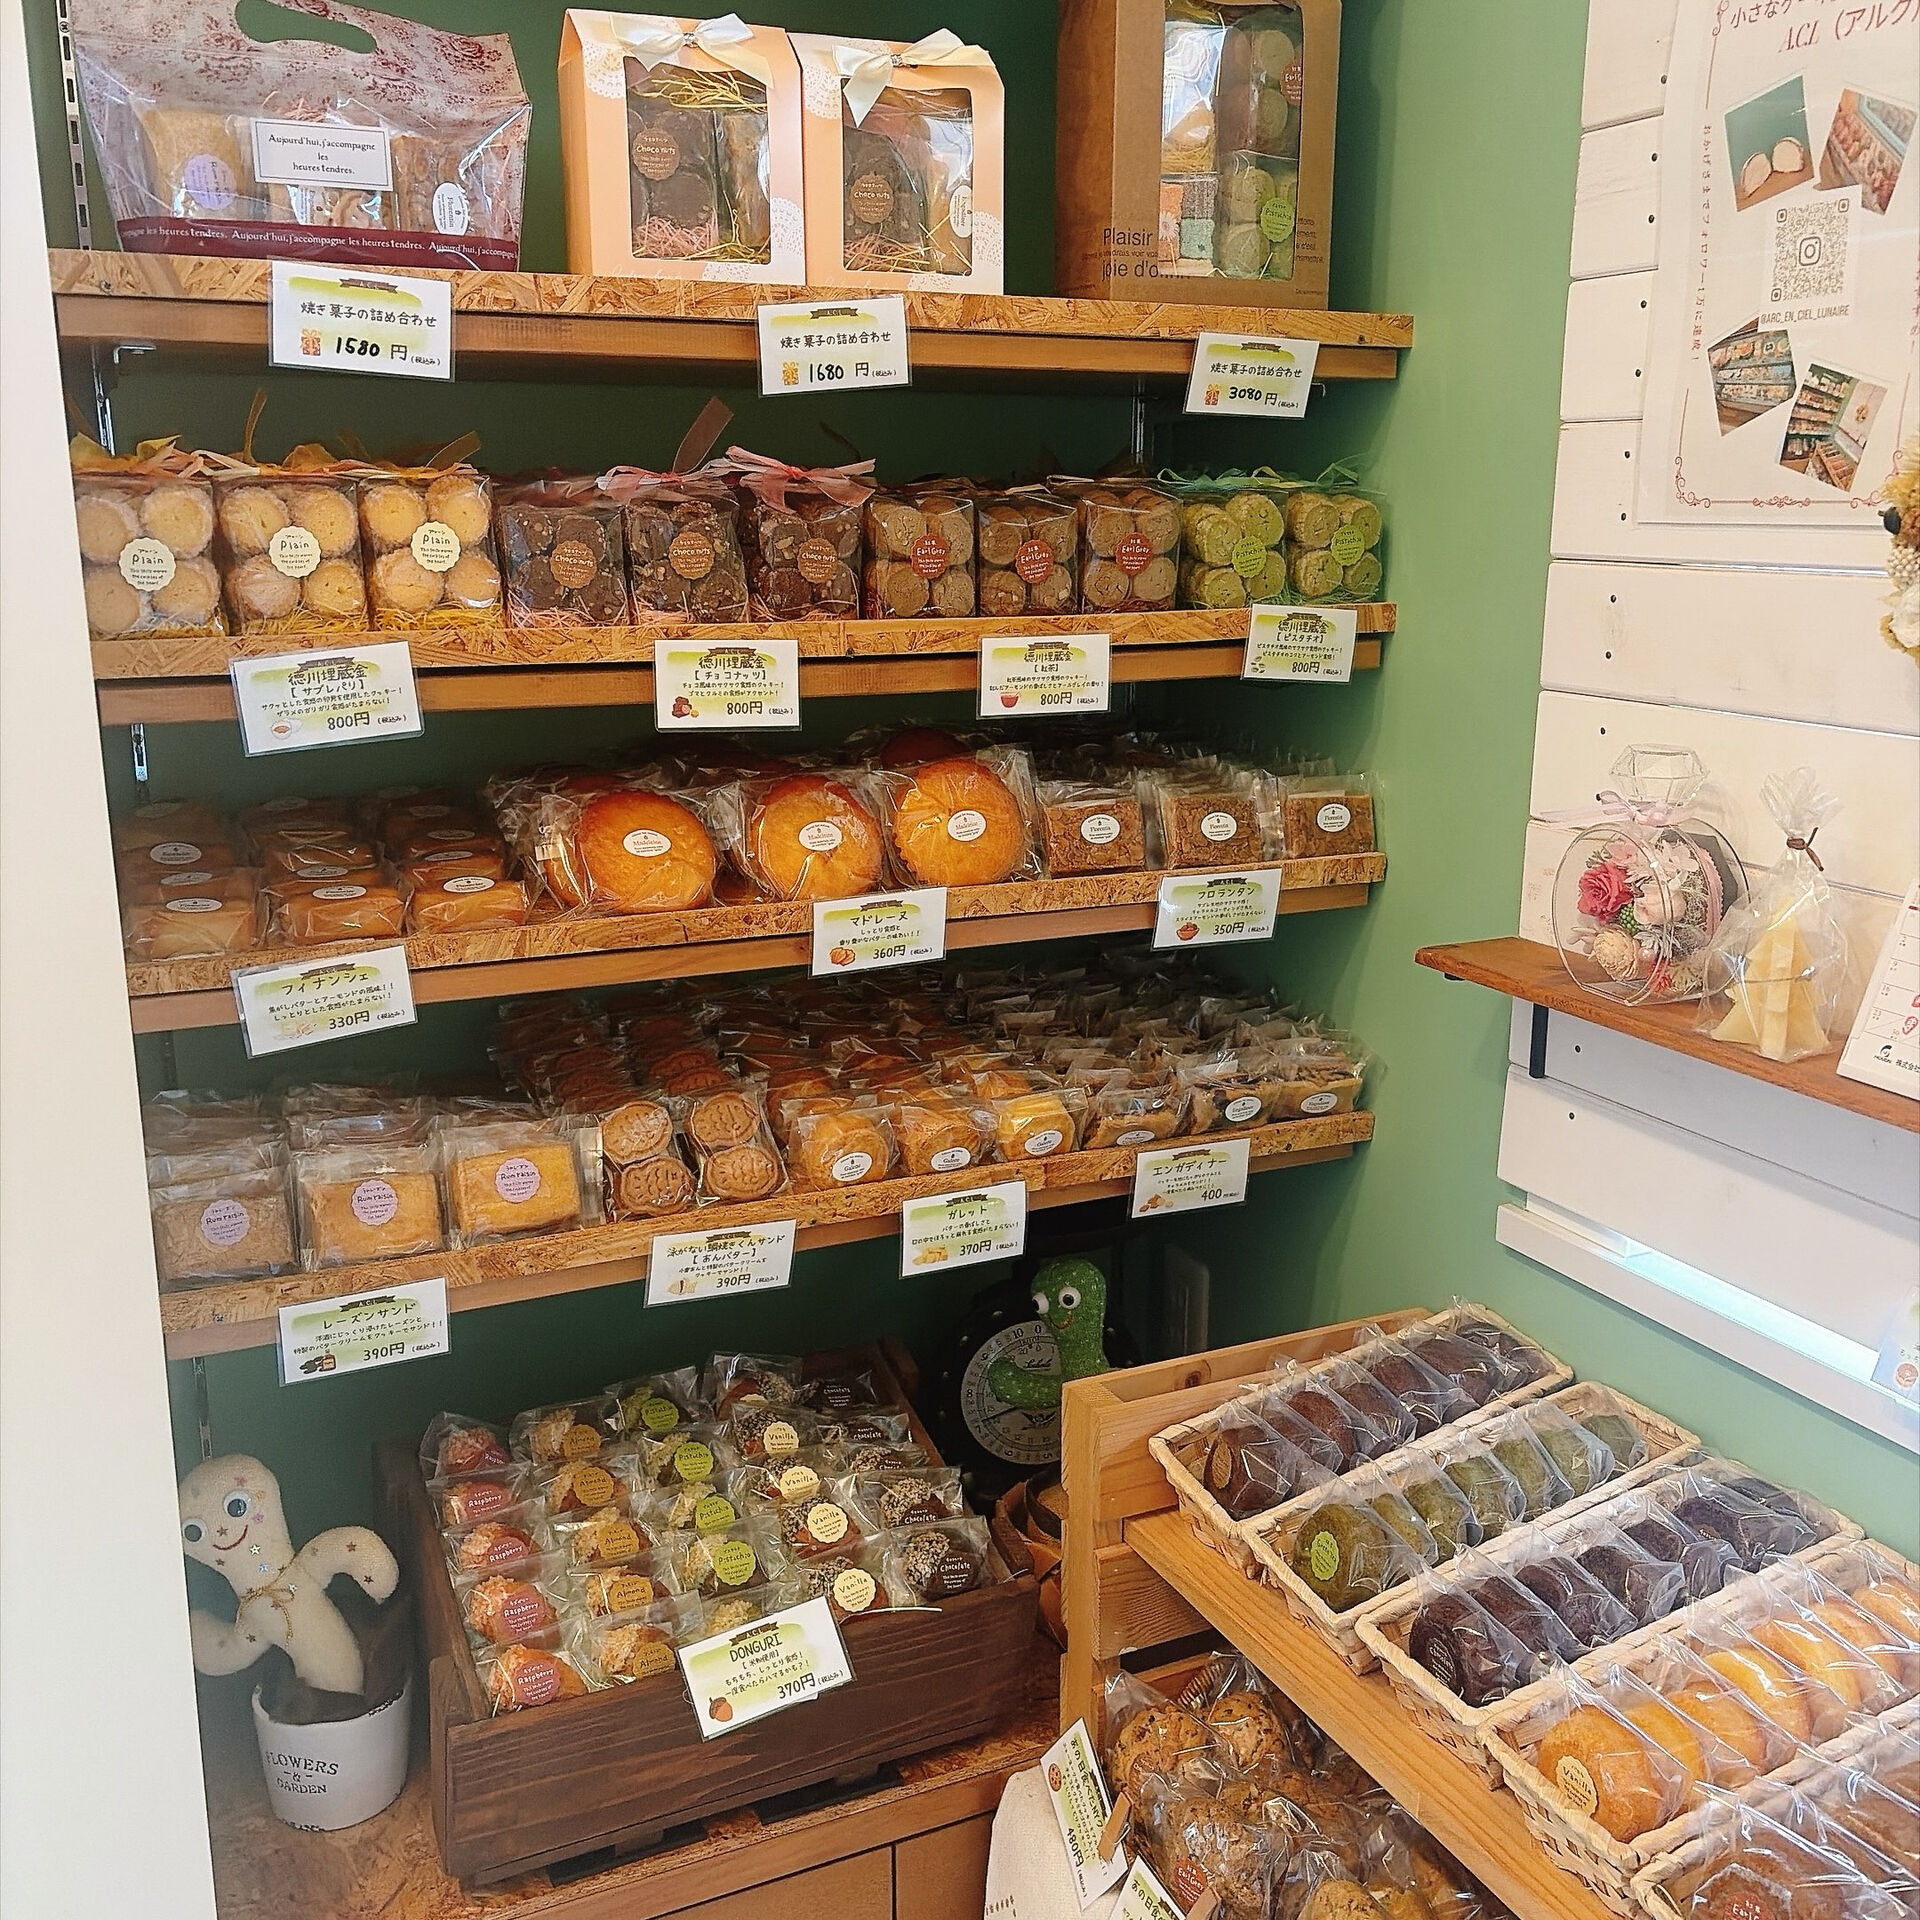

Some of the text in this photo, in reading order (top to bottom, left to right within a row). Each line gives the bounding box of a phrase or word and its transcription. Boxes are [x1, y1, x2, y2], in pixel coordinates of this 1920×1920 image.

[317, 152, 329, 161] les
[1103, 227, 1153, 246] Plaisir
[335, 336, 380, 357] 1580
[391, 344, 408, 360] 円
[809, 363, 844, 383] 1680
[855, 362, 869, 377] 円
[1228, 386, 1262, 401] 3080
[1264, 392, 1278, 406] 円
[280, 540, 309, 551] Plain
[422, 534, 451, 546] Plain
[132, 553, 164, 565] Plain
[699, 655, 767, 670] 徳川埋蔵金
[1291, 661, 1320, 674] 800円
[287, 664, 369, 686] 徳川埋蔵金
[1040, 691, 1073, 706] 800円
[727, 701, 763, 715] 800円
[327, 710, 370, 731] 800円
[1198, 887, 1255, 900] フロランタン
[850, 911, 908, 926] マドレーヌ
[1213, 921, 1245, 935] 350円
[873, 944, 906, 960] 360円
[281, 972, 369, 995] フィナンシェ
[329, 1010, 370, 1030] 330円
[1152, 1157, 1227, 1177] エンガディナー
[1201, 1188, 1222, 1202] 400
[947, 1205, 987, 1220] ガレット
[959, 1239, 992, 1257] 370円
[716, 1273, 751, 1289] 390円
[322, 1302, 417, 1330] レーズンサンド
[363, 1341, 405, 1361] 390円
[966, 1388, 974, 1399] 8
[503, 1601, 539, 1618] Raspberry
[729, 1632, 783, 1662] DONGURI
[517, 1668, 554, 1685] Raspberry
[777, 1672, 816, 1699] 370円
[264, 1750, 339, 1776] FLOWERS
[277, 1777, 328, 1794] GARDEN
[1066, 1828, 1084, 1867] 480円
